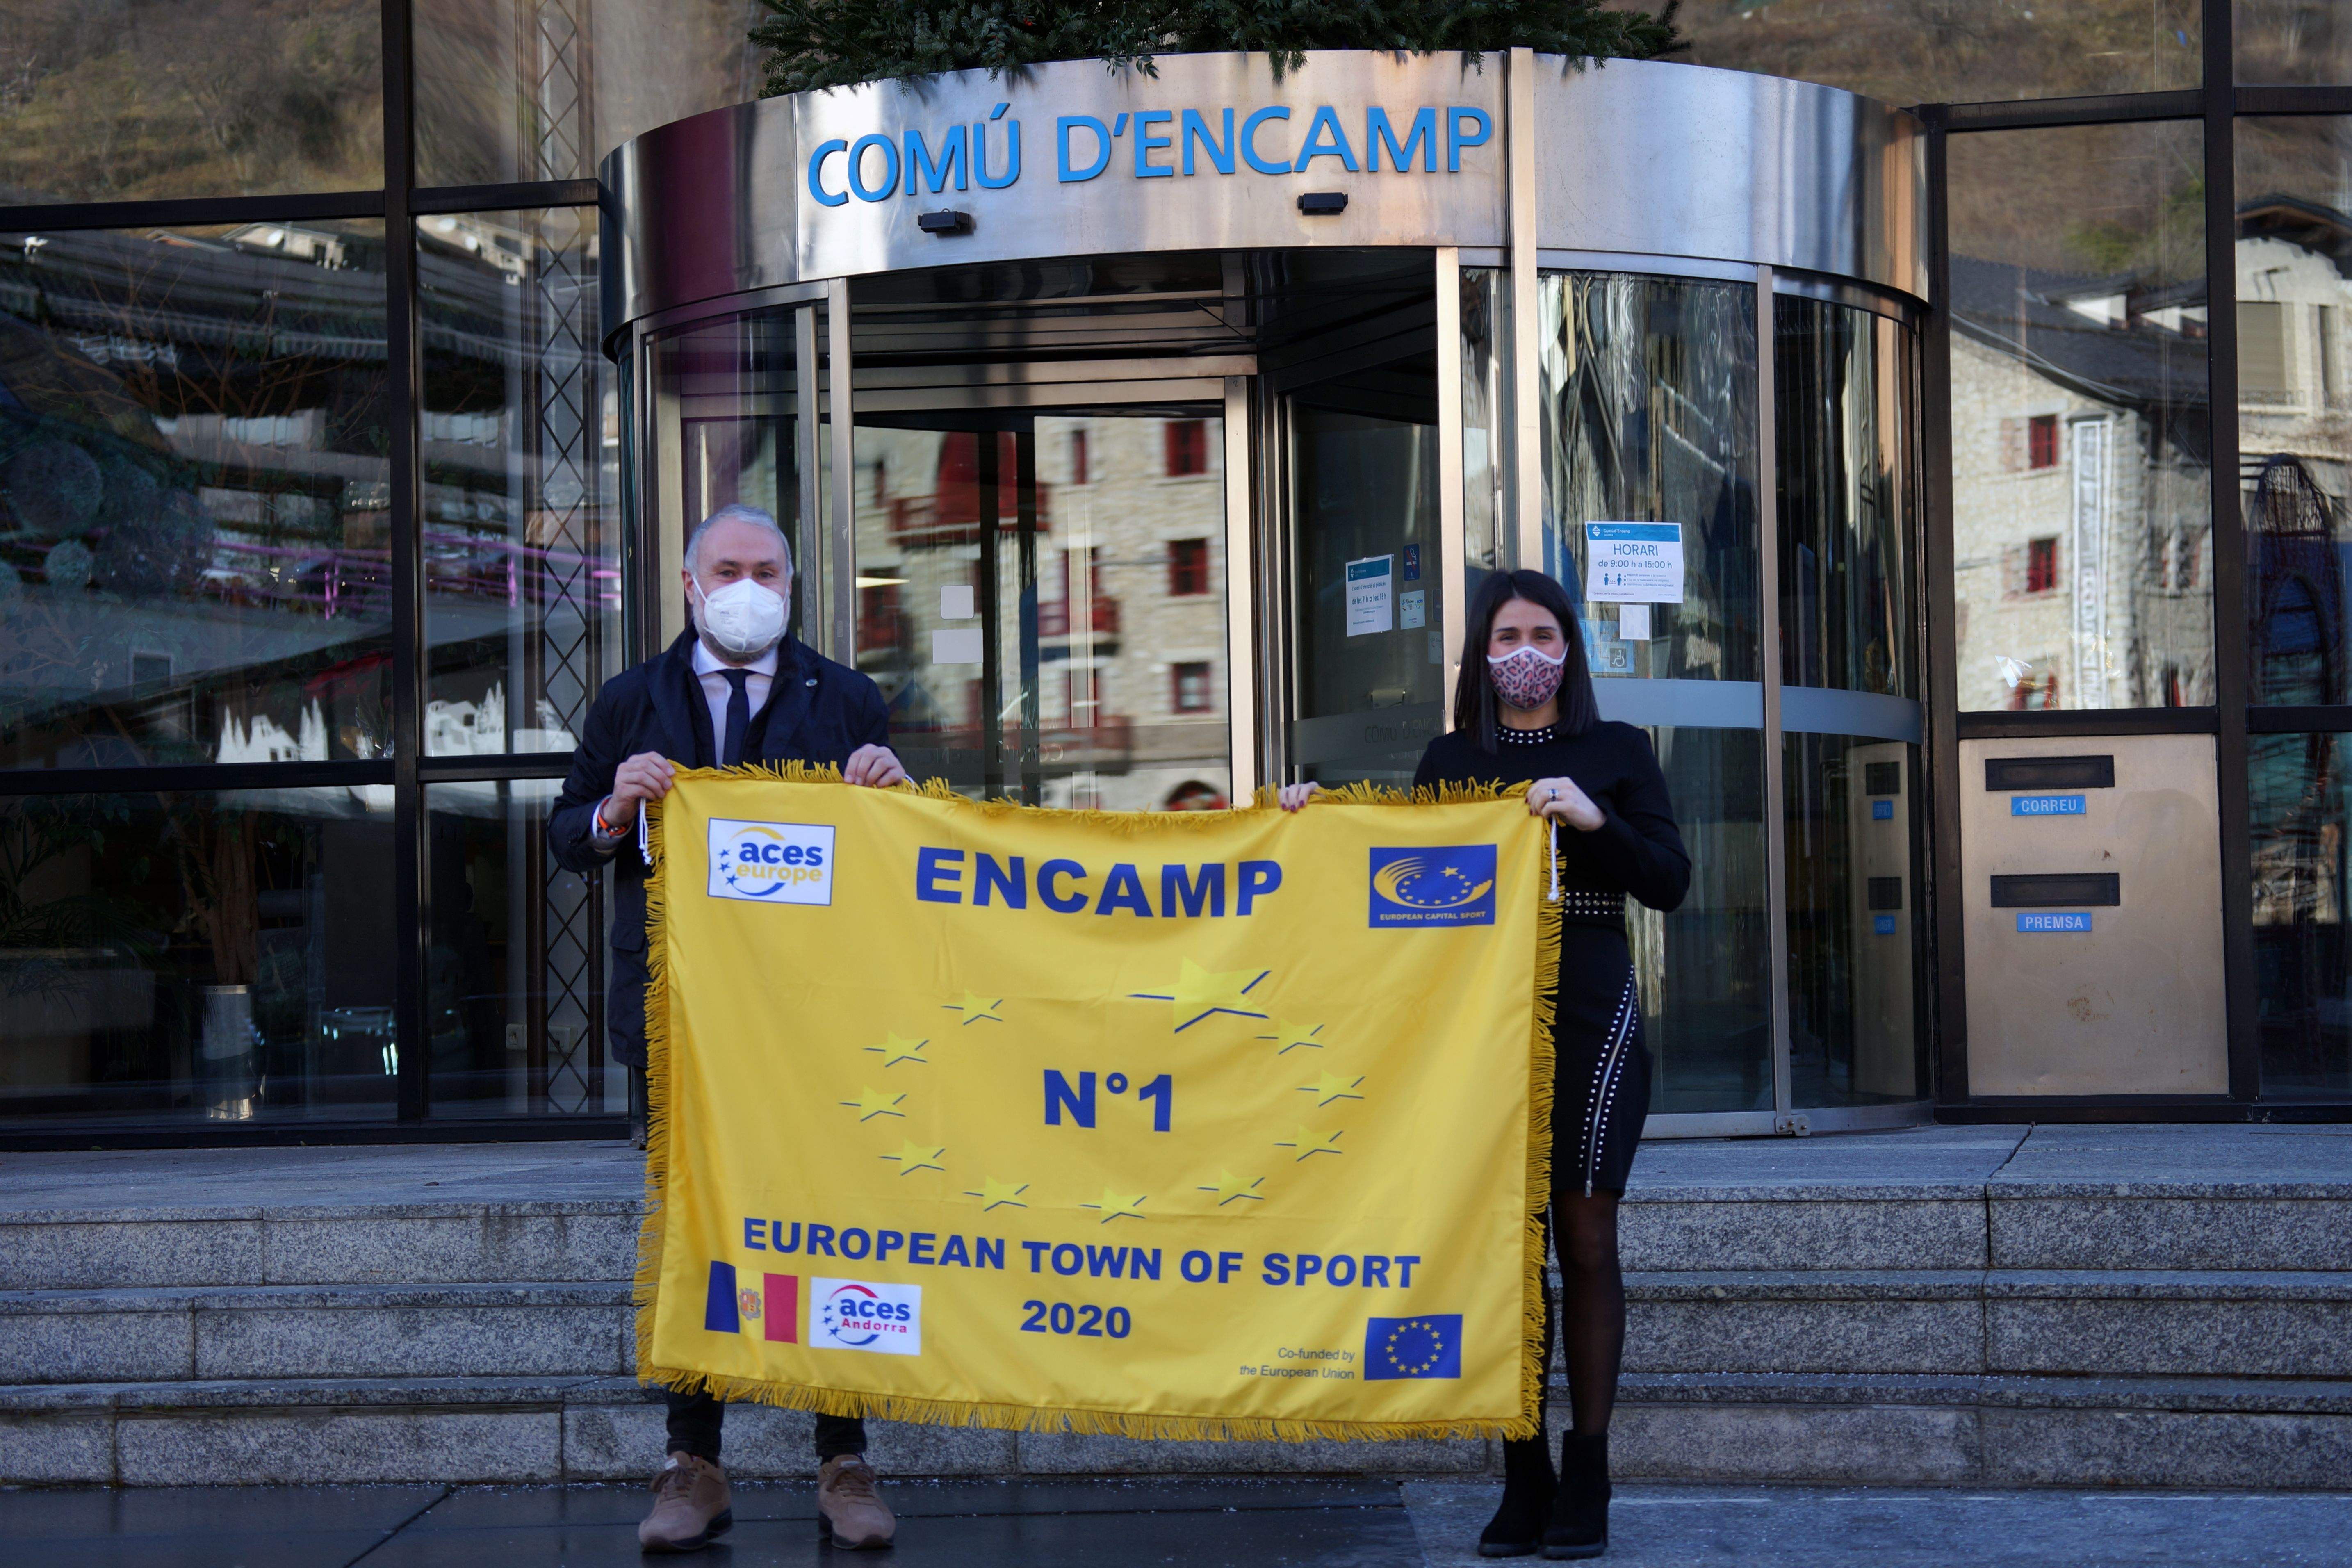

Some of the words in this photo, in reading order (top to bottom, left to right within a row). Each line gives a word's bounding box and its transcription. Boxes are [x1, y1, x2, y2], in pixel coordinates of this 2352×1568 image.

[807, 103, 1021, 207] COMÚ
[1056, 105, 1493, 183] D'ENCAMP
[1614, 544, 1659, 556] HORARI
[1645, 561, 1665, 569] 15:00
[1380, 593, 1384, 601] 15
[2022, 799, 2076, 812] CORREU
[739, 842, 823, 866] aces
[736, 863, 823, 885] europe
[916, 846, 1283, 918] ENCAMP
[1460, 911, 1486, 919] SPORT
[2026, 916, 2083, 929] PREMSA
[744, 1217, 1005, 1269] EUROPEAN
[1022, 1241, 1161, 1280] TOWN
[1180, 1250, 1243, 1283] OF
[1262, 1253, 1420, 1288] SPORT
[840, 1299, 910, 1321] aces
[842, 1318, 907, 1333] Andorra
[1020, 1300, 1131, 1338] 2020
[1278, 1347, 1340, 1360] Co-funded
[1342, 1350, 1355, 1363] by
[1240, 1365, 1257, 1375] the
[1260, 1365, 1319, 1379] European
[1323, 1367, 1355, 1379] Union
